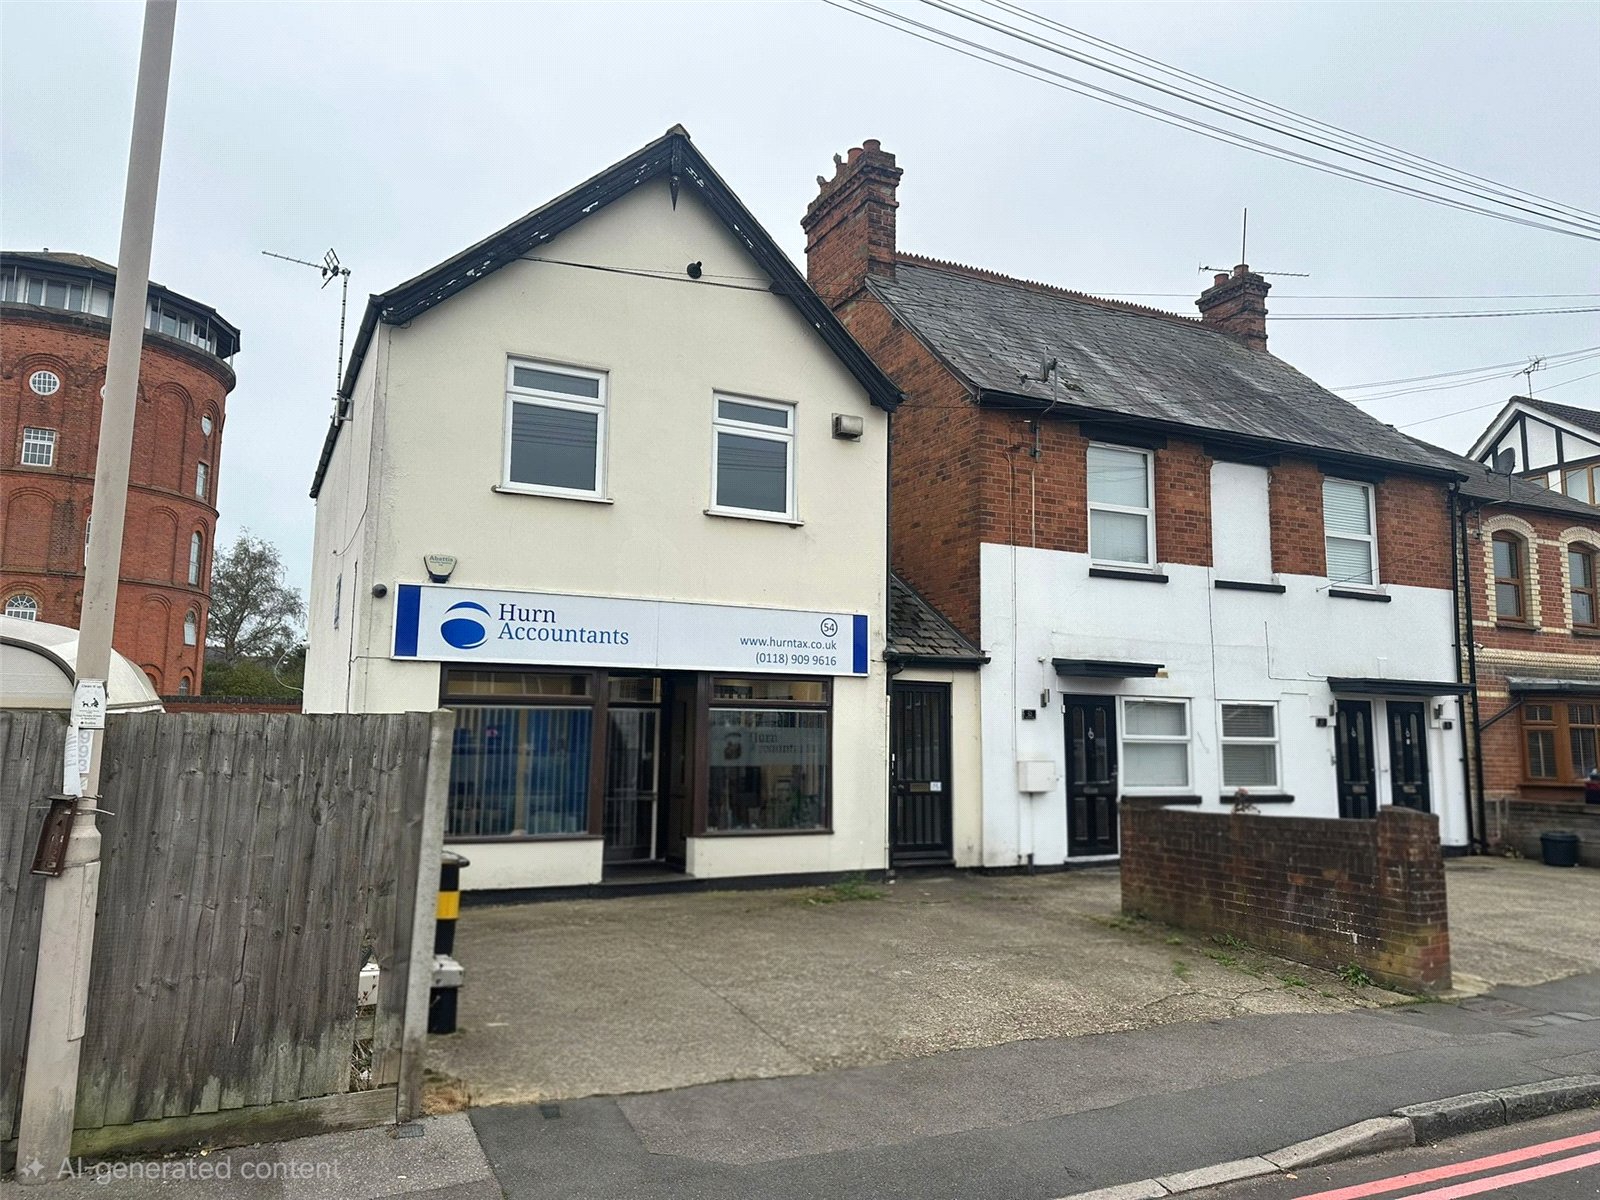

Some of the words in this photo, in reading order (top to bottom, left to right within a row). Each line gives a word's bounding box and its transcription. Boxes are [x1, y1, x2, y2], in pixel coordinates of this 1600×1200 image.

[498, 603, 556, 623] Hurn
[498, 622, 629, 645] Accountants
[823, 622, 835, 632] 54
[740, 636, 837, 650] www.hurntax.co.uk
[755, 652, 788, 665] (0118)
[791, 654, 810, 665] 909
[812, 655, 837, 666] 9616
